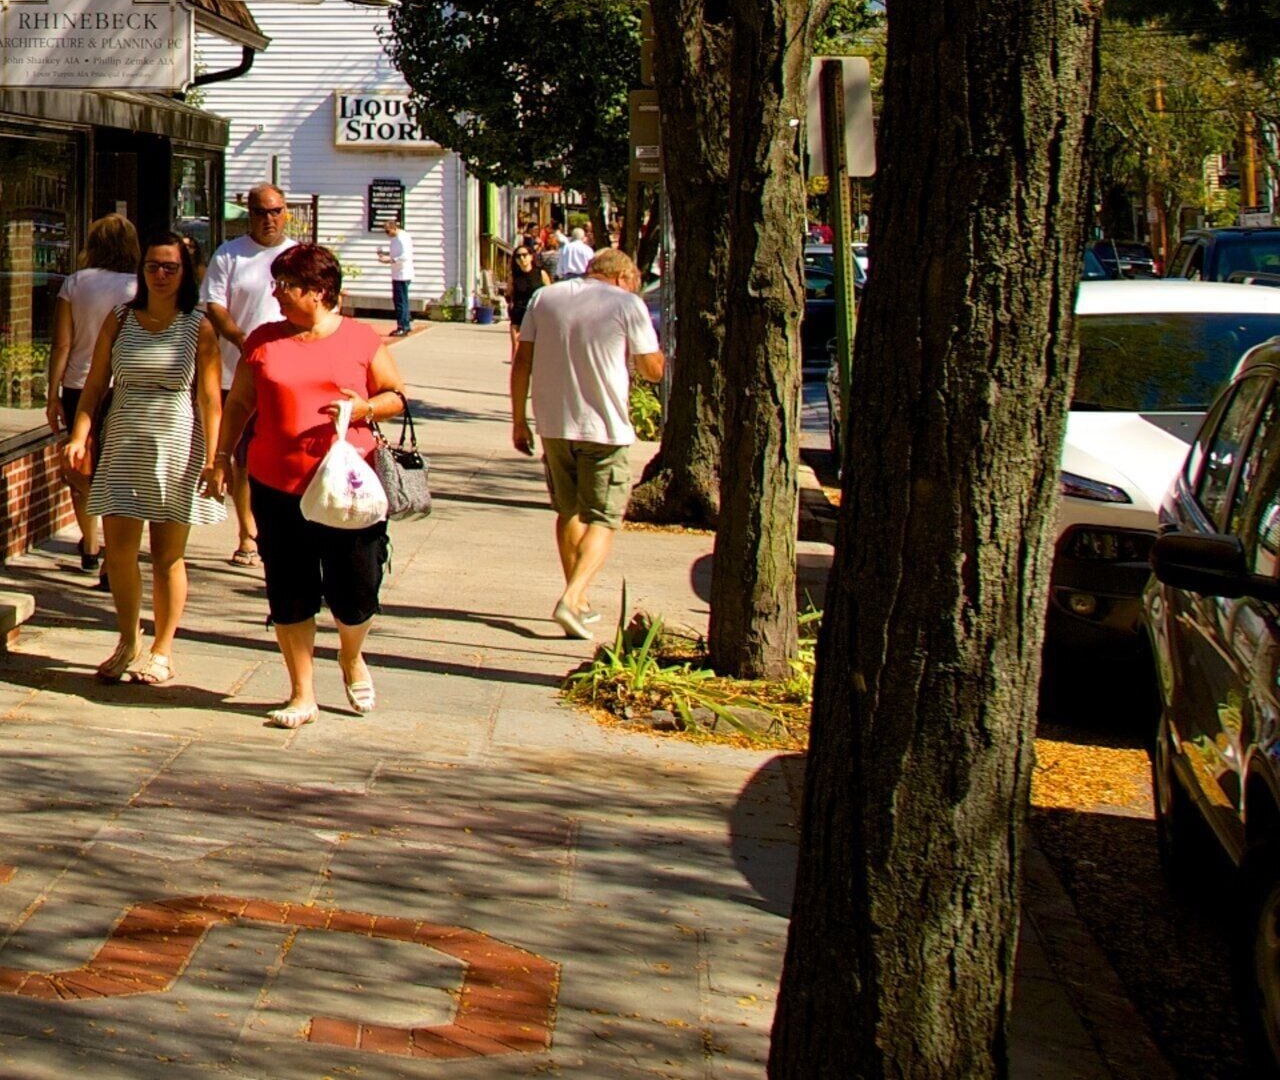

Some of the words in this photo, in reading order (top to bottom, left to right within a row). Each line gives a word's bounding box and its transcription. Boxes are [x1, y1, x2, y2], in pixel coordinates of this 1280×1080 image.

[19, 12, 158, 30] RHINEBECK
[89, 38, 97, 48] &
[101, 38, 163, 49] PLANNING
[340, 96, 419, 120] LIQU
